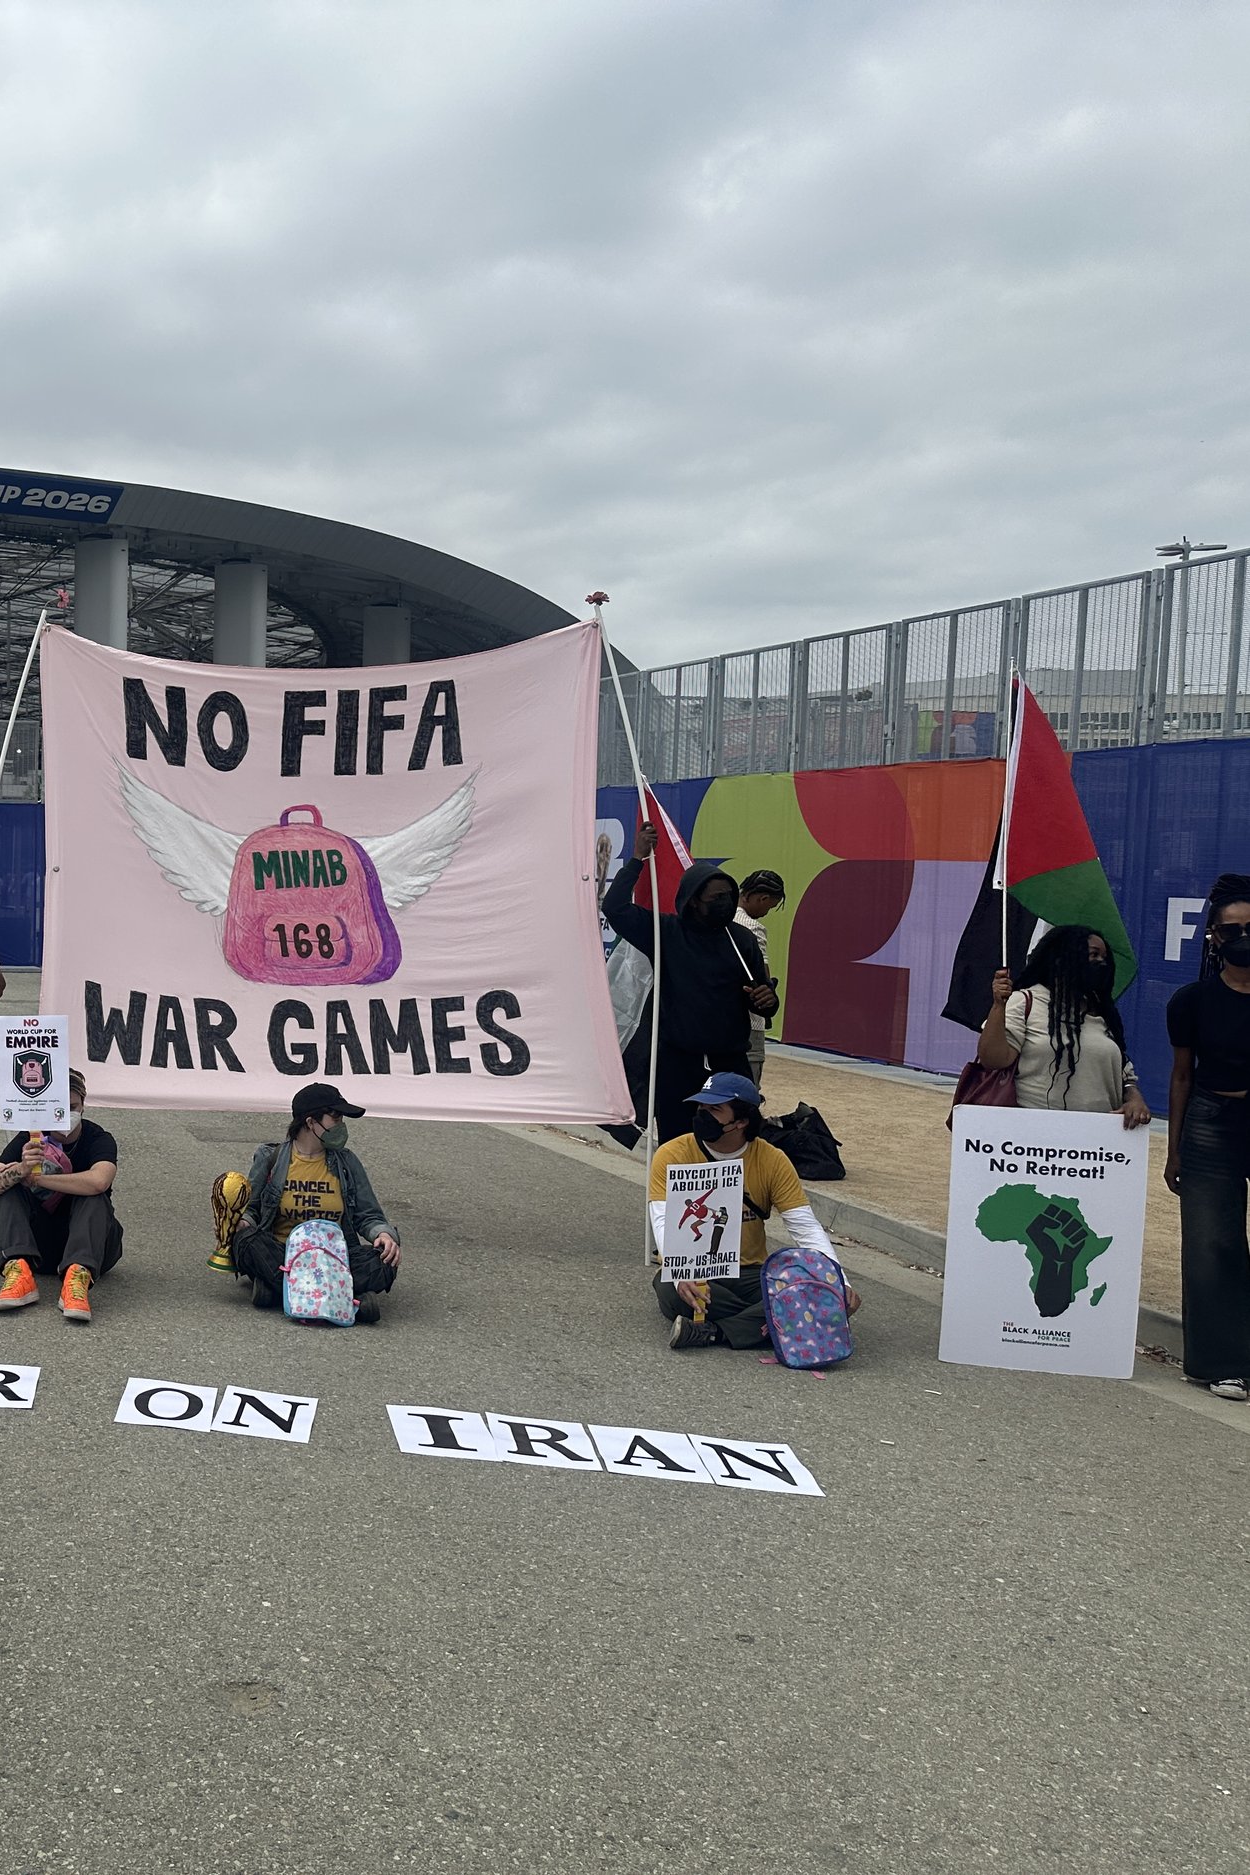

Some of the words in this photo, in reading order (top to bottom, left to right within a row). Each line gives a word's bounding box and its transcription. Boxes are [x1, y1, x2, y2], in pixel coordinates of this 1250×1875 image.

[21, 487, 112, 514] 2026
[121, 676, 249, 772] NO
[280, 678, 463, 777] FIFA
[251, 848, 348, 890] MINAB
[272, 922, 336, 960] 168
[23, 1019, 39, 1027] NO
[84, 980, 246, 1073] WAR
[266, 989, 532, 1076] GAMES
[5, 1036, 59, 1048] EMPIRE
[964, 1138, 994, 1153] No
[1000, 1141, 1131, 1165] Compromise,
[669, 1167, 718, 1180] BOYCOTT
[721, 1165, 742, 1177] FIFA
[989, 1158, 1018, 1174] No
[1026, 1160, 1105, 1180] Retreat!
[672, 1179, 718, 1192] ABOLISH
[722, 1176, 739, 1188] ICE
[293, 1194, 321, 1207] THE
[279, 1207, 342, 1221] LYMPICS
[664, 1256, 687, 1268] STOP
[671, 1268, 691, 1280] WAR
[693, 1265, 730, 1279] MACHINE
[1002, 1326, 1029, 1334] BLACK
[1032, 1329, 1071, 1337] ALLIANCE
[134, 1387, 308, 1433] ON
[407, 1412, 798, 1487] IRAN
